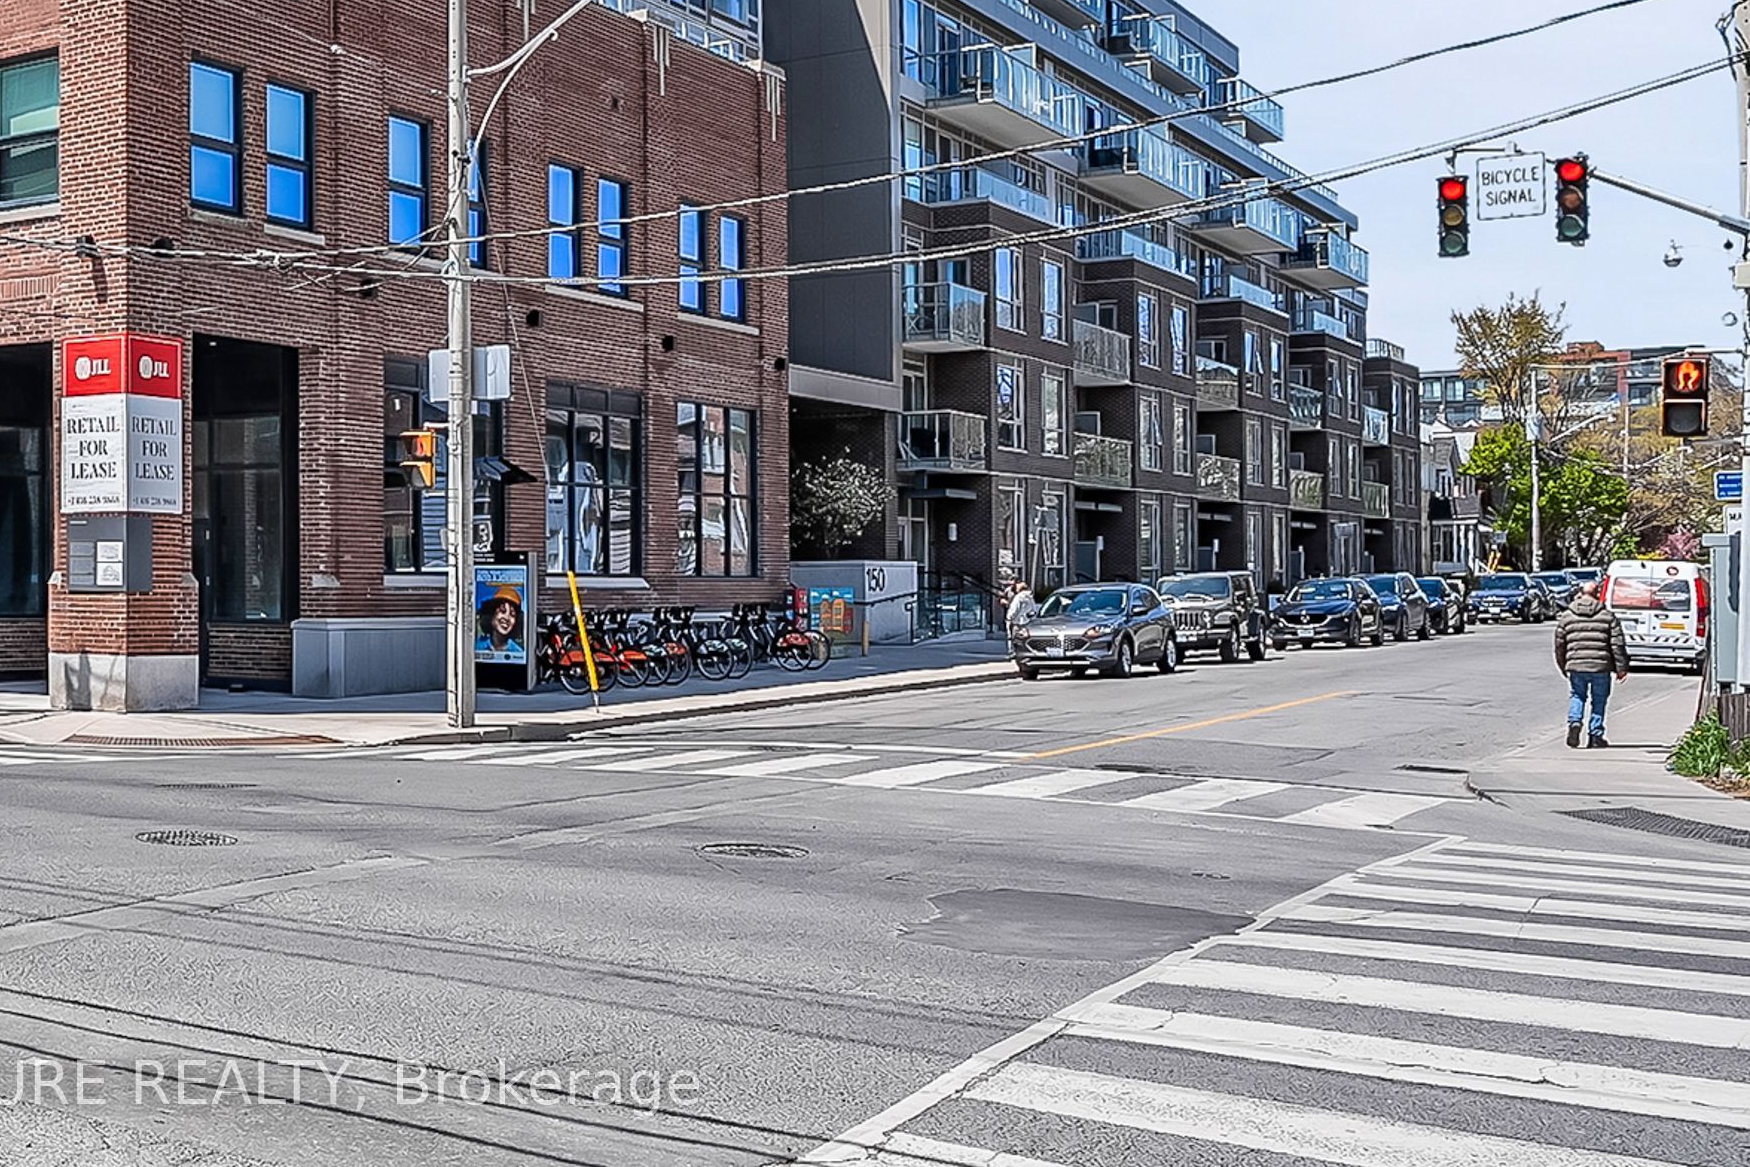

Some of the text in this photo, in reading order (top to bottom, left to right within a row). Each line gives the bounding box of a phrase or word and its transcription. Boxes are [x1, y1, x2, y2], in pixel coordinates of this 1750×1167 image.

[1481, 166, 1539, 186] BICYCLE
[1486, 188, 1537, 207] SIGNAL
[67, 416, 121, 434] RETAIL
[131, 416, 177, 436] RETAIL
[79, 440, 108, 456] FOR
[142, 440, 168, 457] FOR
[71, 462, 117, 479] LEASE
[135, 463, 175, 480] LEASE
[866, 568, 885, 592] 150
